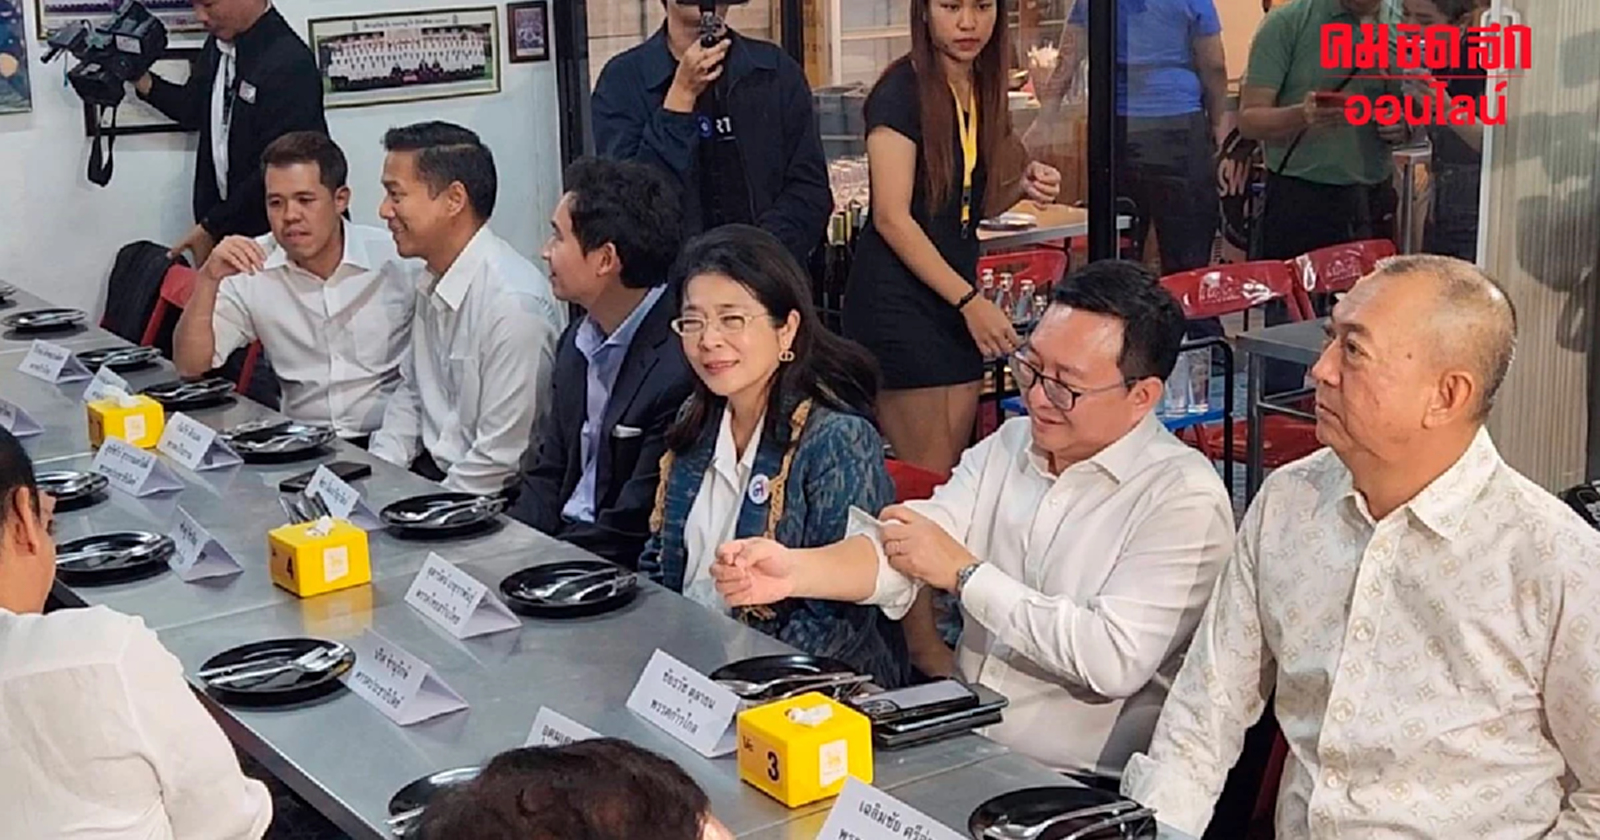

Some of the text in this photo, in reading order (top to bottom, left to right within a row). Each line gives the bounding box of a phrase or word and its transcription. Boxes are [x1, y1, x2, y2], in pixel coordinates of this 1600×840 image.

[286, 556, 294, 580] 4
[650, 699, 699, 735] พรรคก้าวไกล
[767, 751, 779, 781] 3
[859, 800, 902, 833] เฉลิมชัย
